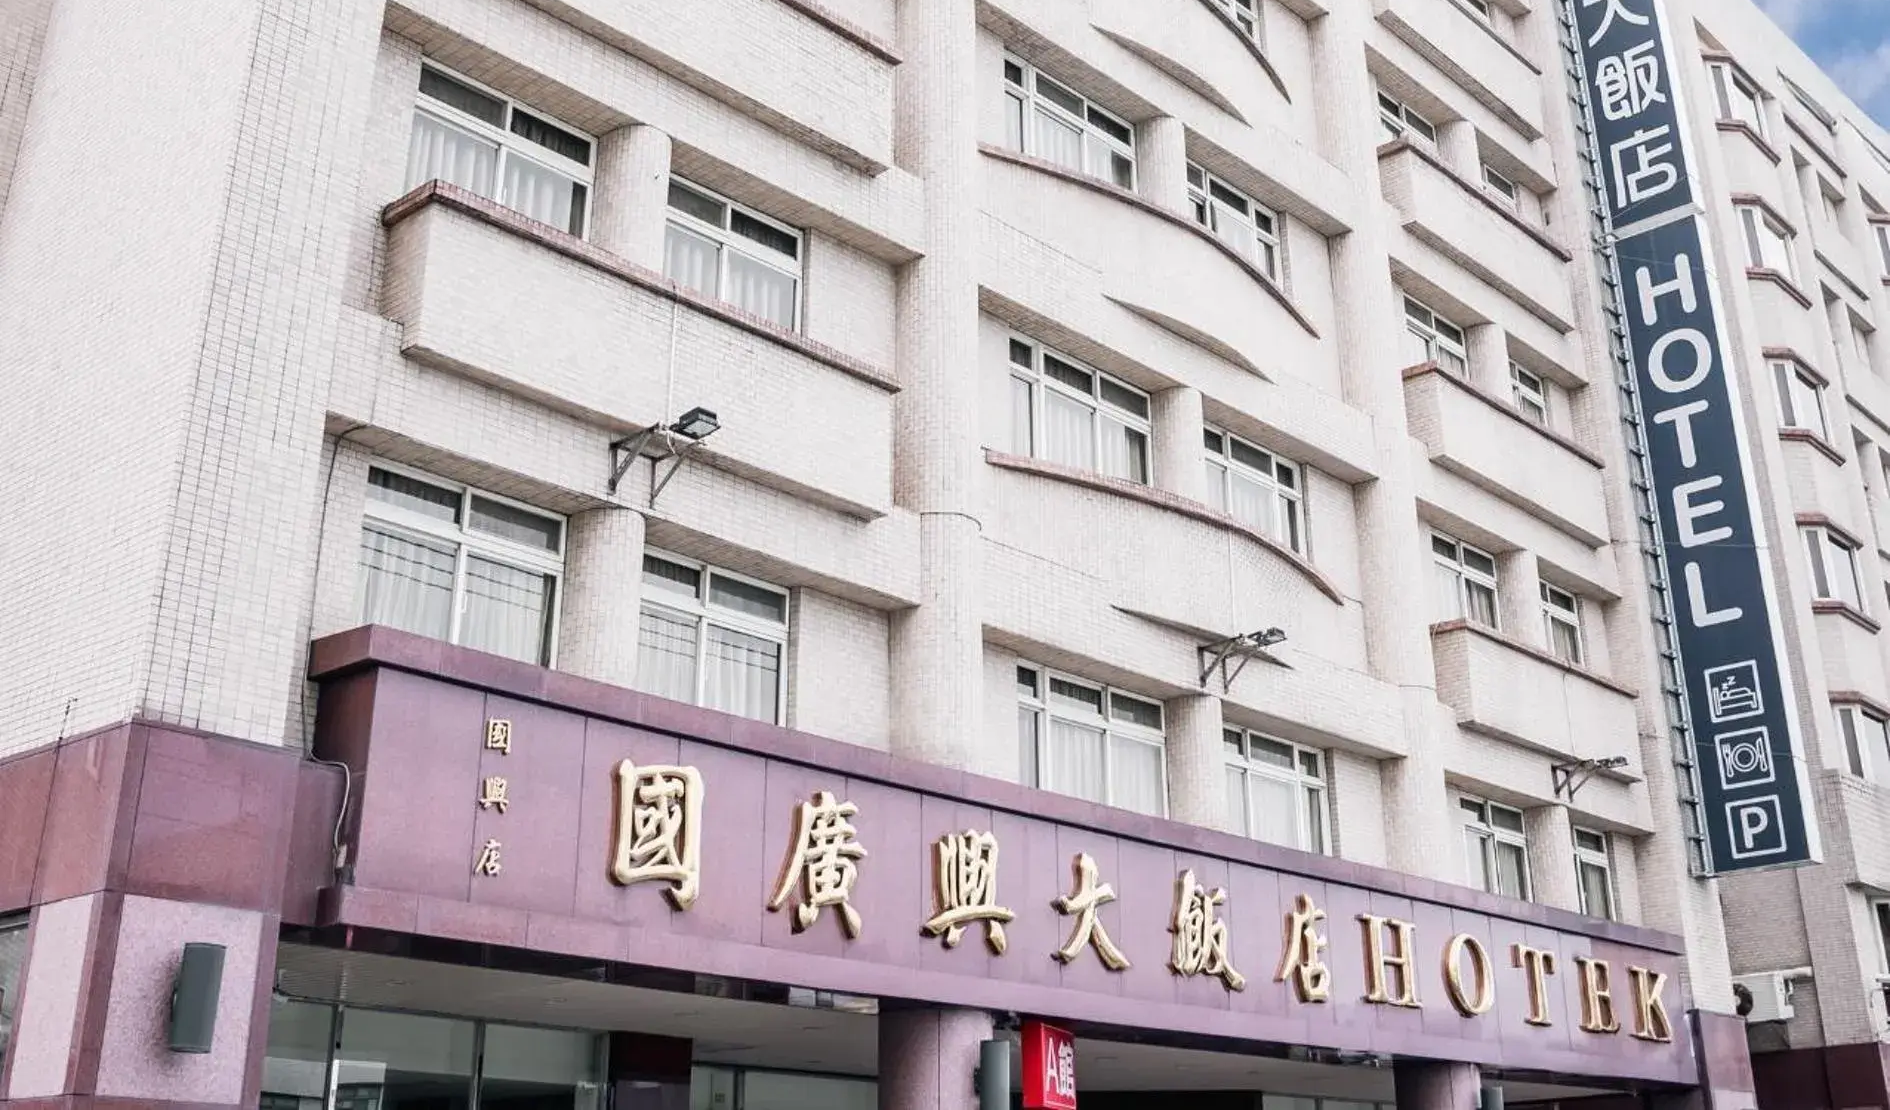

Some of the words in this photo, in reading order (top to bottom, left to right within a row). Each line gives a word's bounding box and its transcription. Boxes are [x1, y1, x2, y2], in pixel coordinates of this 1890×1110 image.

[1636, 253, 1743, 627] HOTEL
[607, 758, 1330, 1003] 國廣興大飯店
[1740, 806, 1768, 849] P
